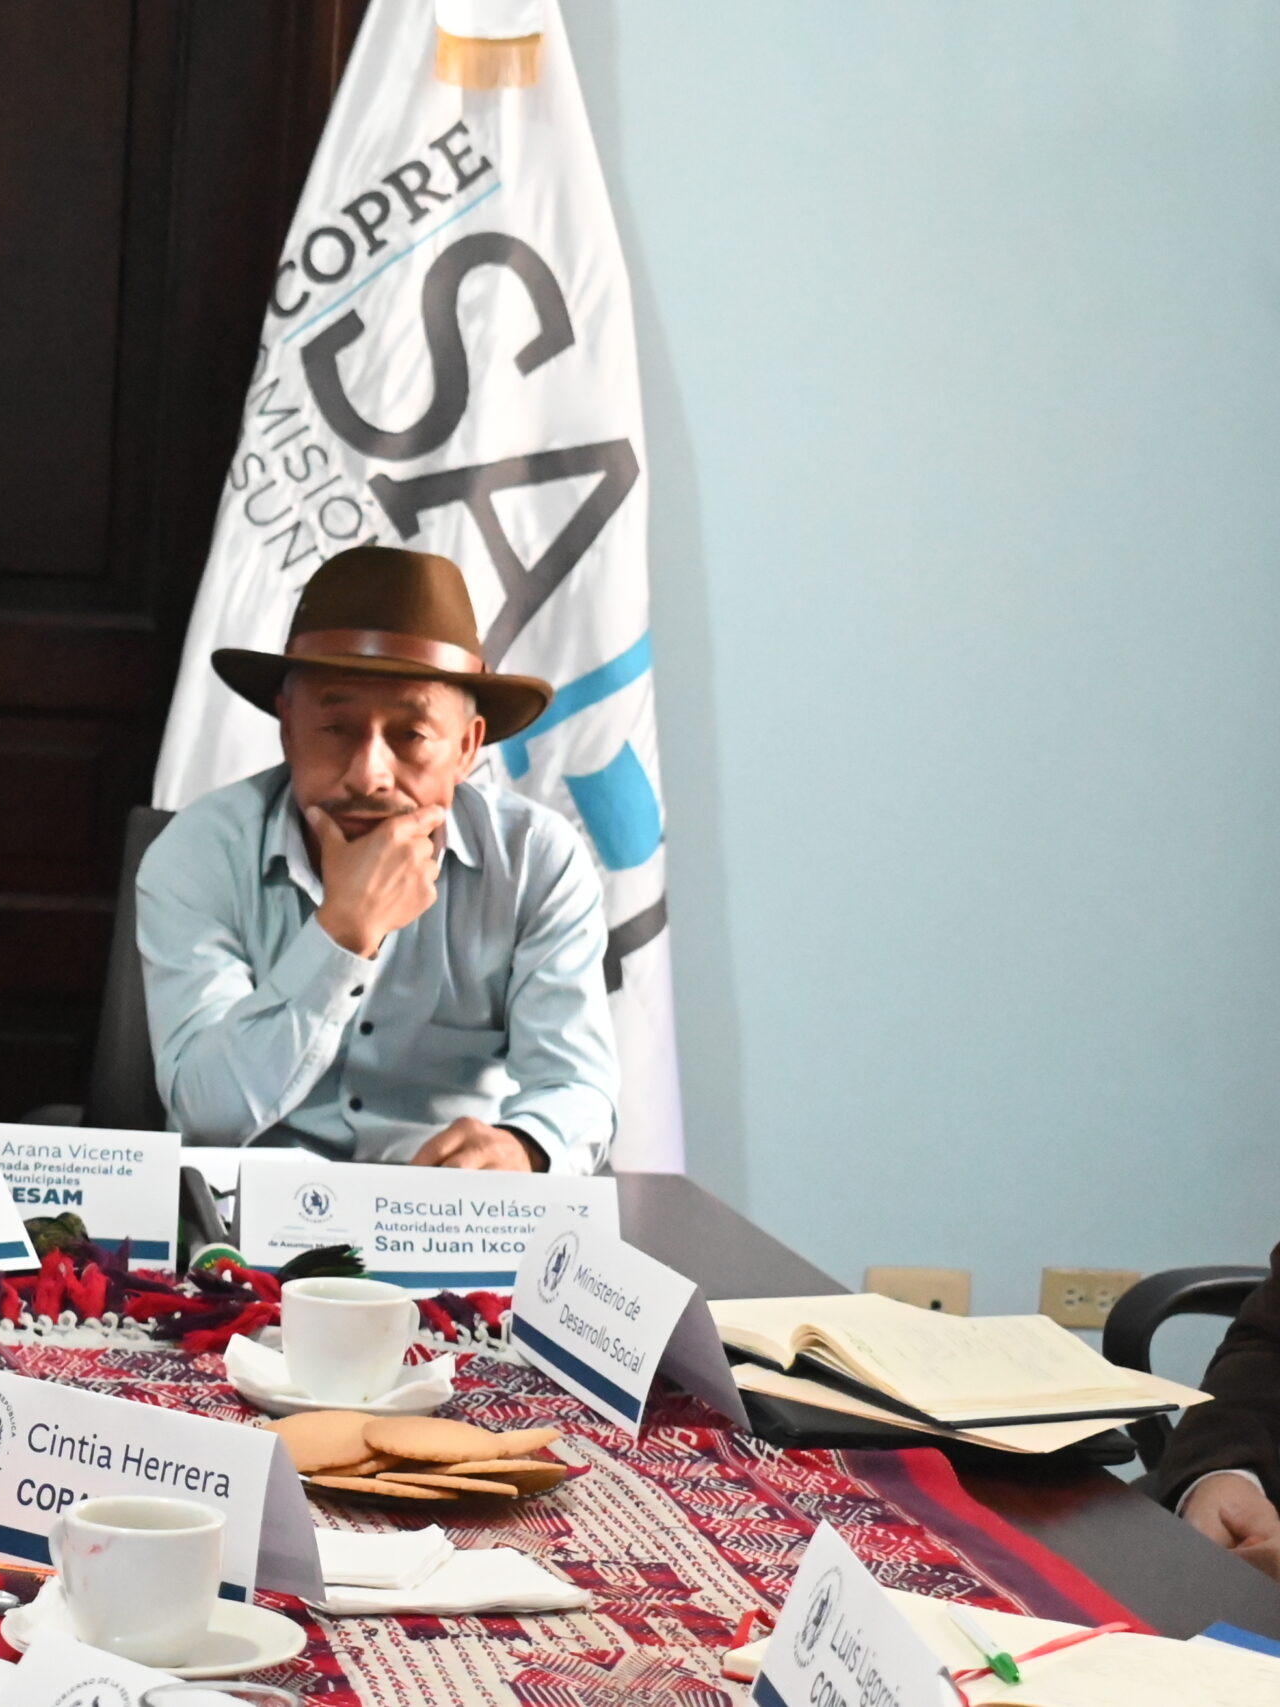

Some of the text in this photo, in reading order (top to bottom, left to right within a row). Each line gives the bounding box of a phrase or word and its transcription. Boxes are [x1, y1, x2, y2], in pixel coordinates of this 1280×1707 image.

[267, 121, 493, 319] COPRE
[231, 453, 326, 592] SUN
[1, 1141, 62, 1158] Arana
[69, 1144, 144, 1162] Vicente
[34, 1162, 113, 1175] Presidencial
[117, 1166, 133, 1176] de
[11, 1187, 83, 1206] ESAM
[375, 1197, 463, 1216] Pascual
[374, 1221, 460, 1233] Autoridades
[375, 1236, 414, 1252] San
[422, 1238, 473, 1253] Juan
[482, 1238, 526, 1253] Ixco
[573, 1264, 625, 1312] Ministerio
[624, 1295, 642, 1321] de
[559, 1304, 646, 1374] Desarrollo Social
[27, 1422, 230, 1498] Cintia Herrera
[16, 1478, 89, 1513] COP
[830, 1613, 861, 1673] Luis
